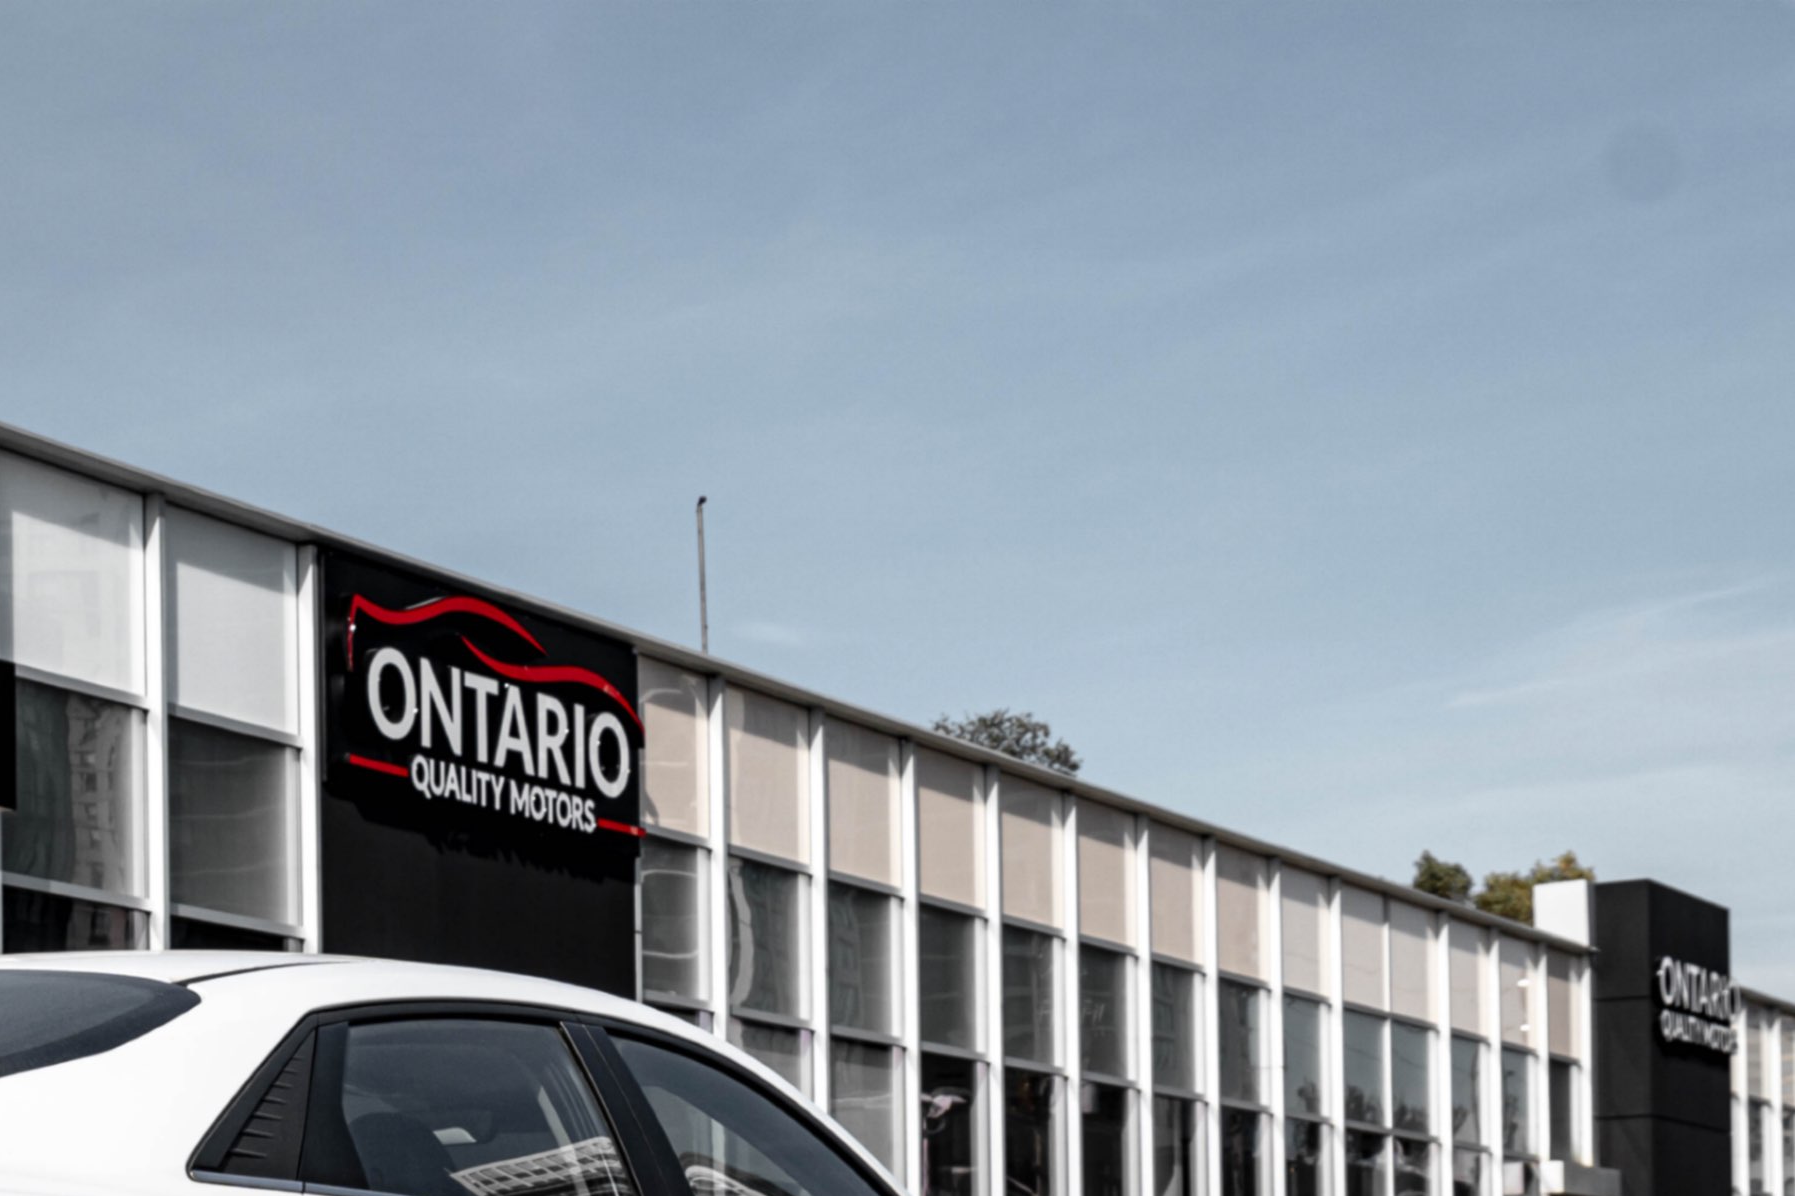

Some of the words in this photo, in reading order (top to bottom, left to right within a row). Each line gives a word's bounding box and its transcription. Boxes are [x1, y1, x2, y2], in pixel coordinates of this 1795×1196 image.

[367, 646, 631, 799] ONTARIO
[411, 754, 505, 811] QUALITY
[509, 779, 597, 834] MOTORS
[1657, 956, 1742, 1023] ONTARIO
